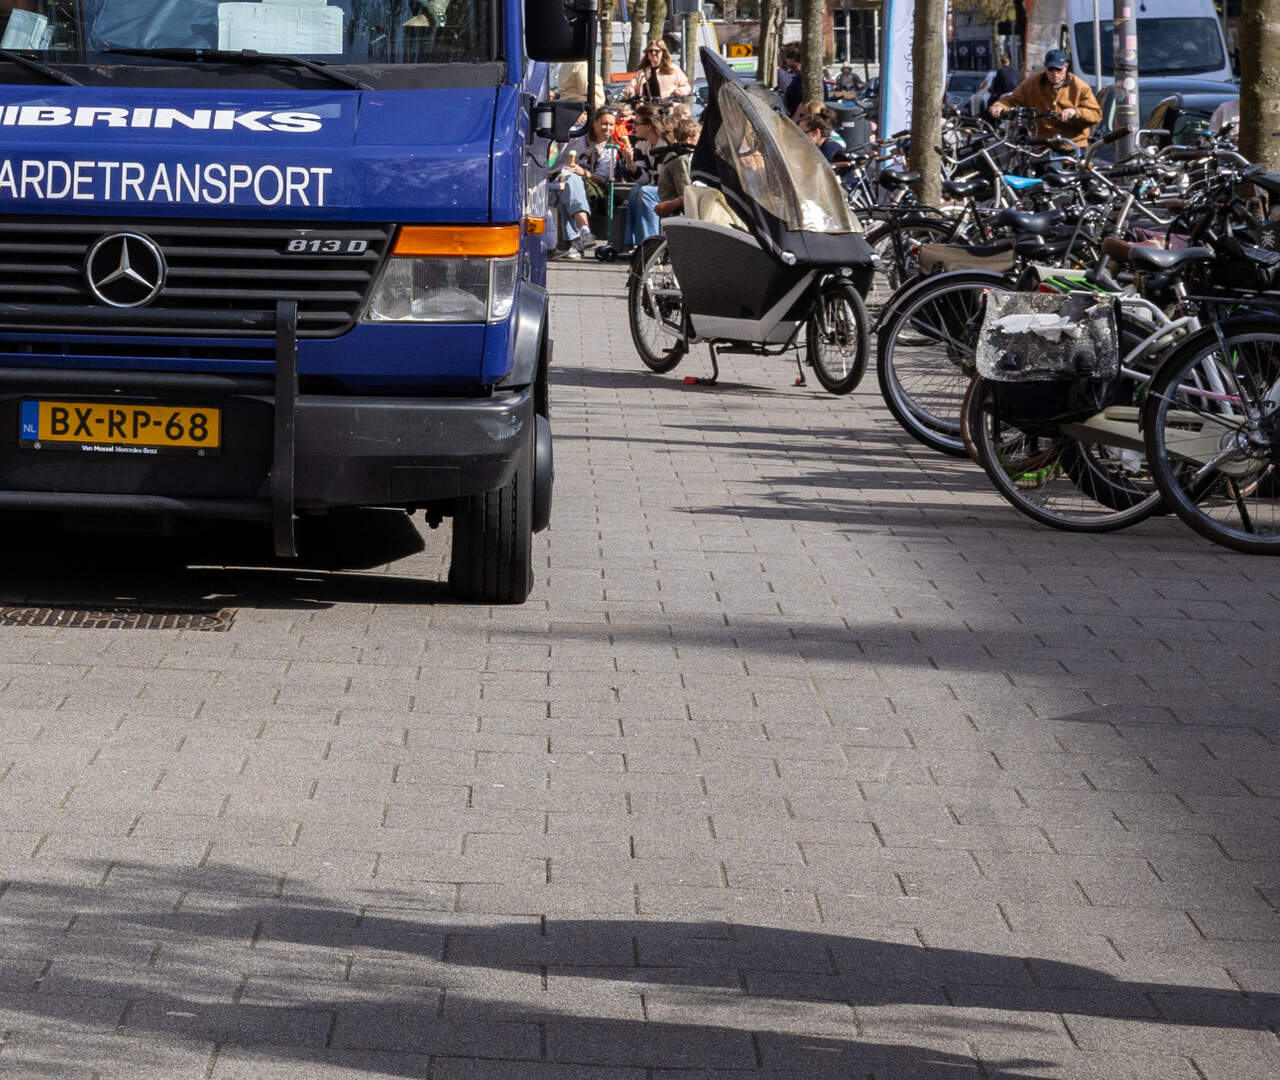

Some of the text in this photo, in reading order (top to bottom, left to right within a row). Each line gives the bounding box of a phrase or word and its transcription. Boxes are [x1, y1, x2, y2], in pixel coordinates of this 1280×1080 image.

[17, 105, 323, 133] BRINKS
[287, 239, 342, 253] 813
[23, 423, 37, 434] NL
[50, 406, 209, 442] BX-RP-68
